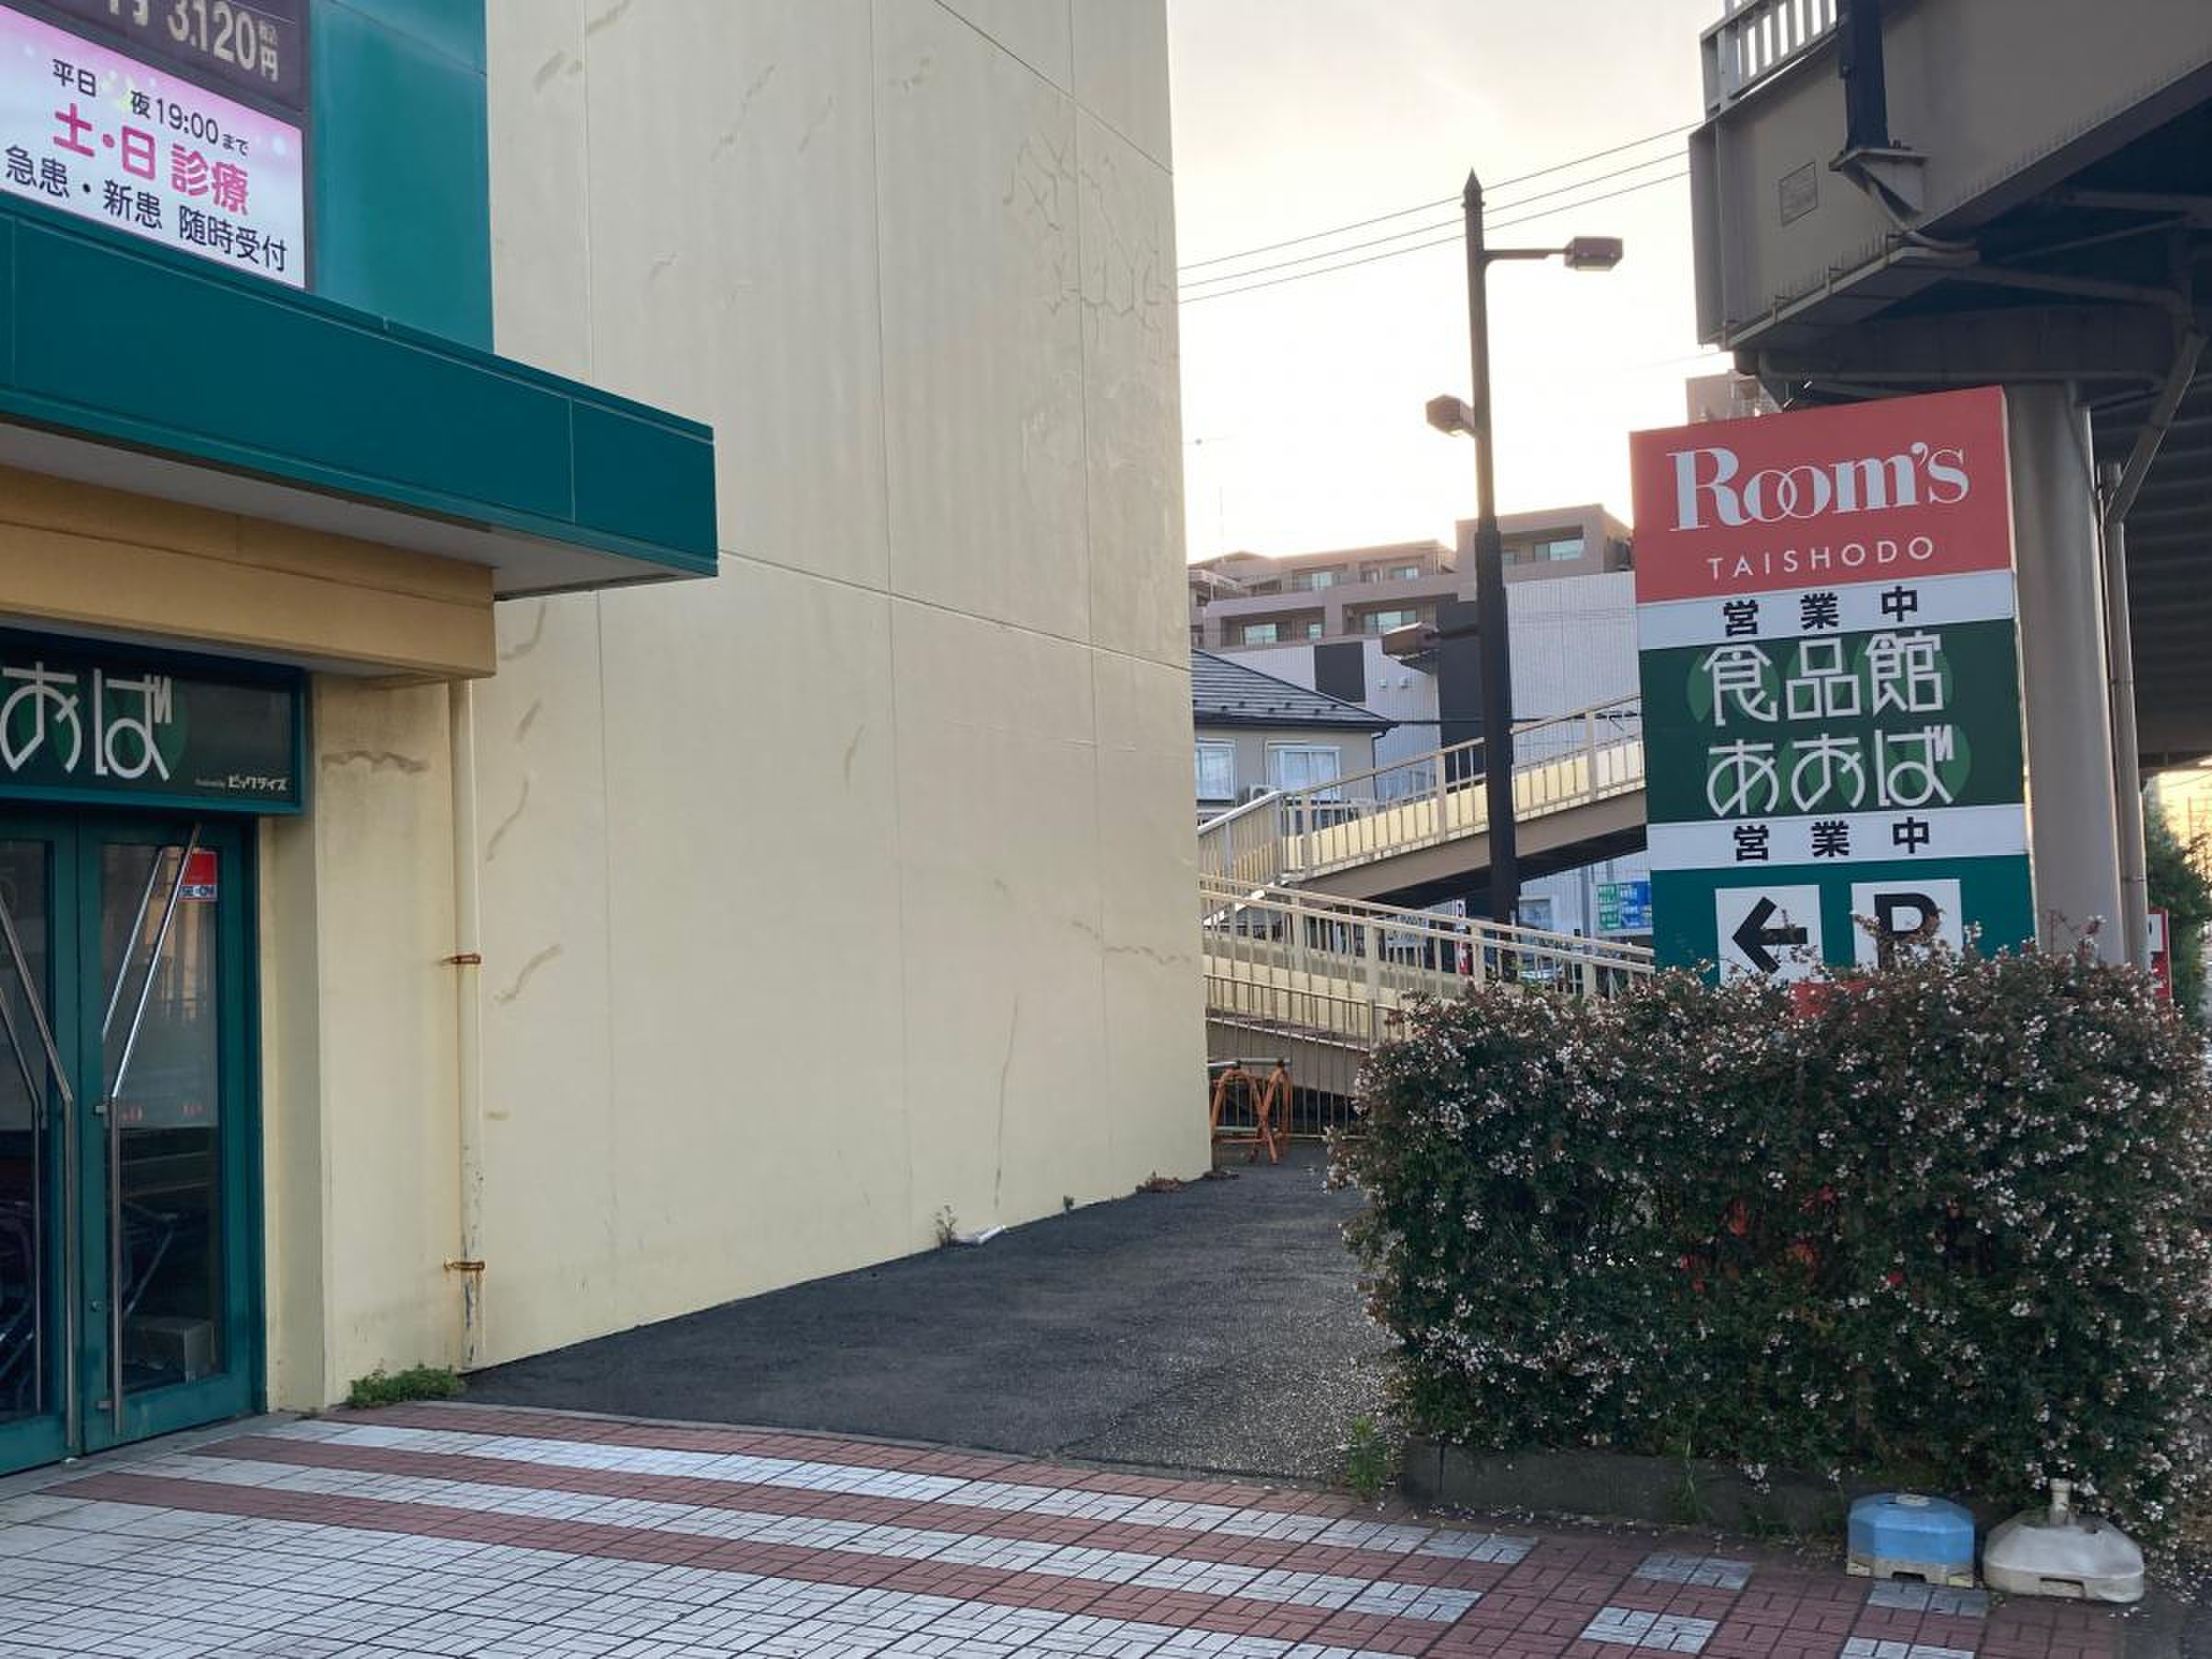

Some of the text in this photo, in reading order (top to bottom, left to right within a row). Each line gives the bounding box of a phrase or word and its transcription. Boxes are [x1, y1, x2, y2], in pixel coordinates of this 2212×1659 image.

[53, 58, 96, 97] 平日
[171, 143, 249, 216] 診療
[179, 205, 288, 272] 随時受付
[1666, 441, 1971, 532] Room's
[1708, 536, 1934, 580] TAISHODO
[1724, 585, 1918, 637] 営業中
[1702, 630, 1945, 727] 食品館
[0, 661, 172, 782] おば
[1706, 724, 1955, 818] あおば
[1734, 817, 1930, 862] 営業中
[1874, 892, 1940, 968] P
